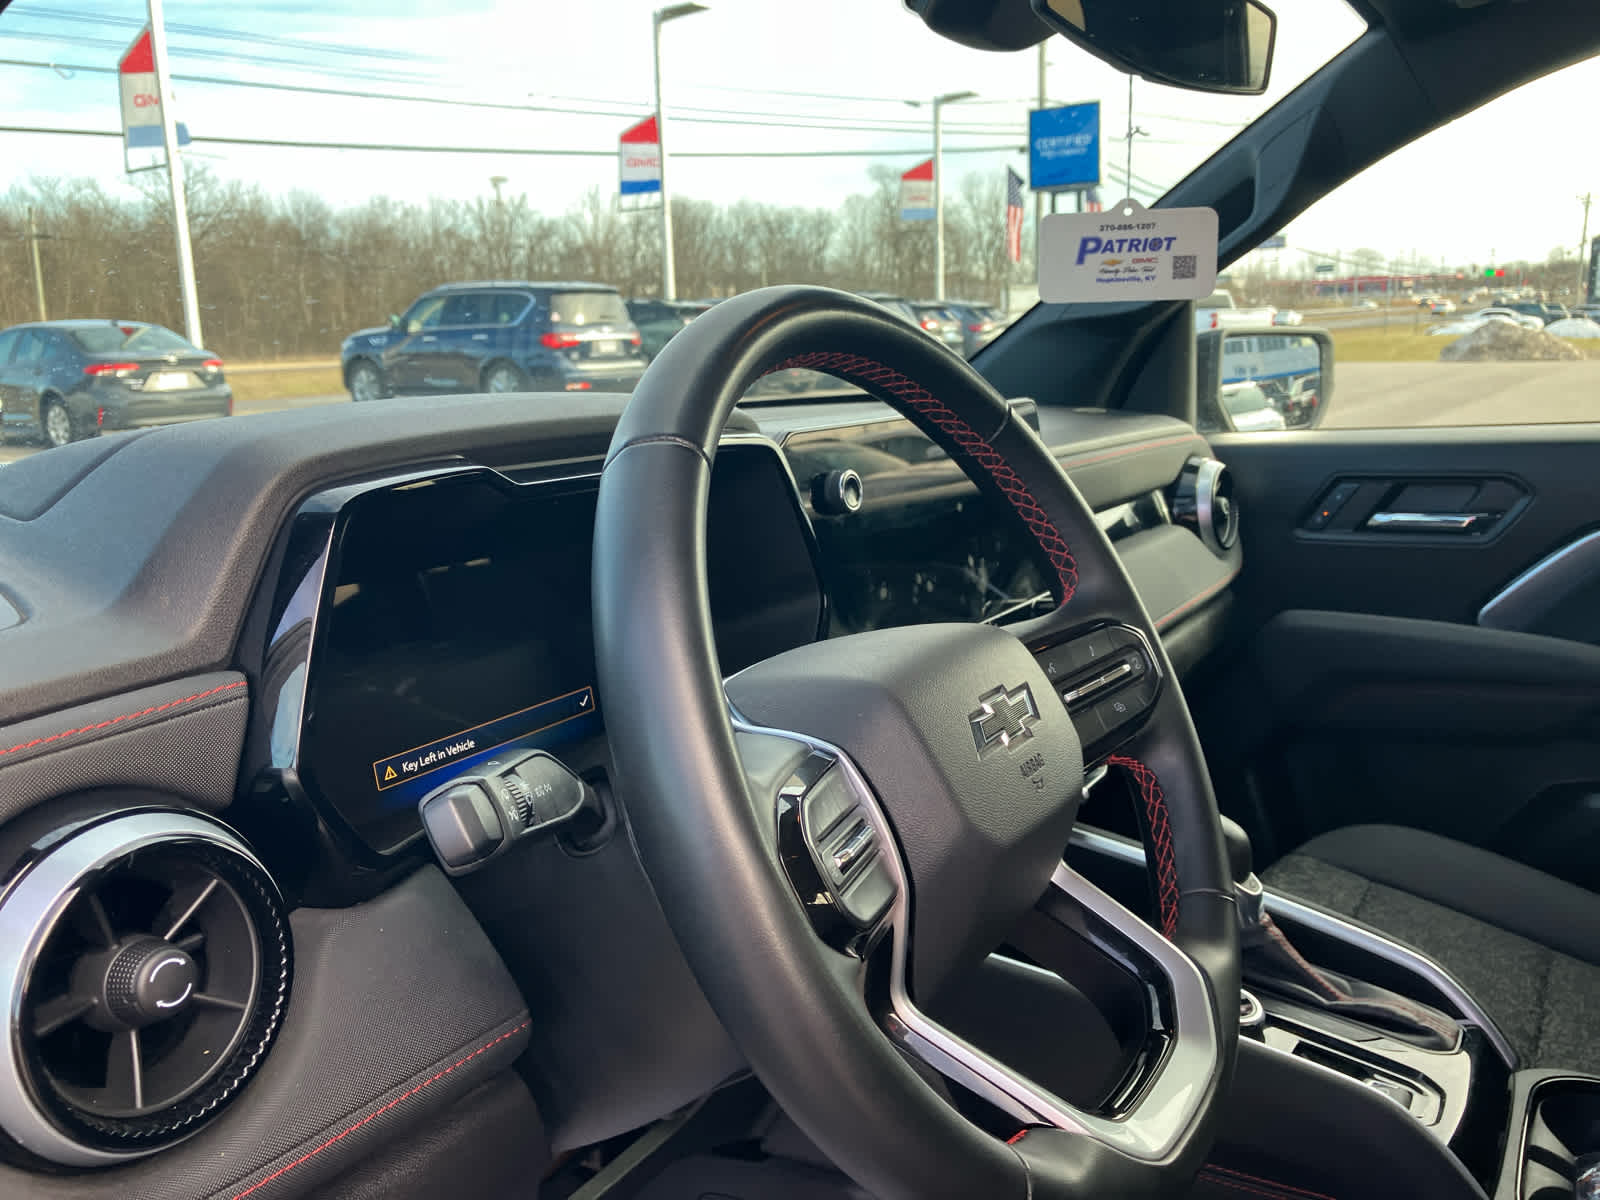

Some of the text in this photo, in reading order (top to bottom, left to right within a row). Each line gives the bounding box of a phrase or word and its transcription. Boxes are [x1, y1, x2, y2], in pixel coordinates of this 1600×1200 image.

[402, 739, 476, 773] Key Left in Vehicle
